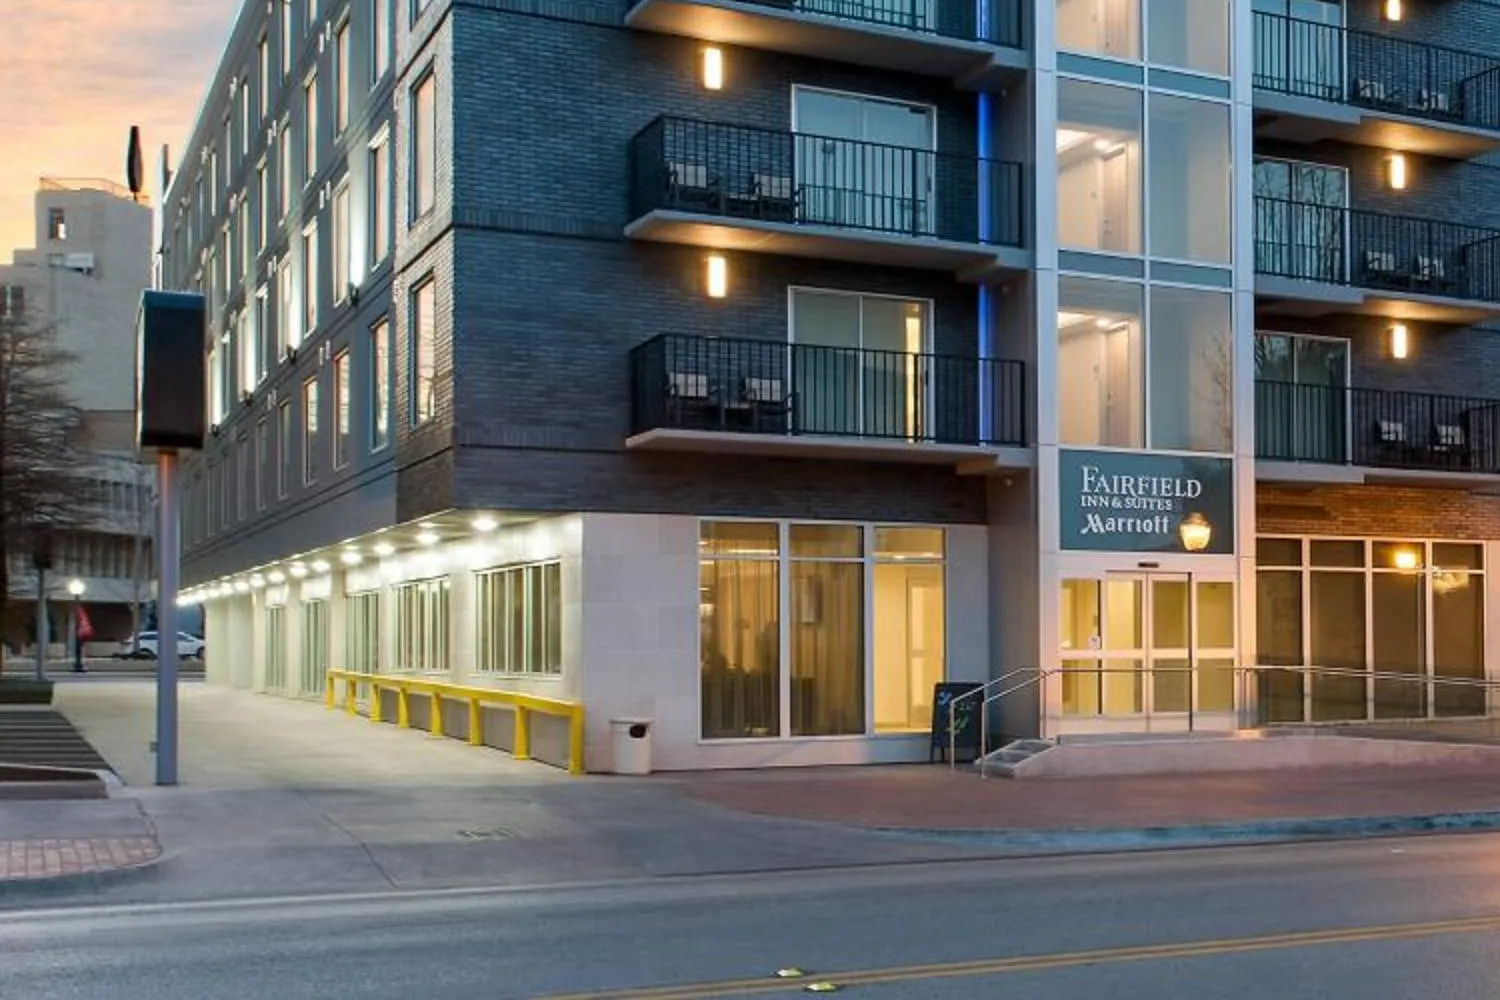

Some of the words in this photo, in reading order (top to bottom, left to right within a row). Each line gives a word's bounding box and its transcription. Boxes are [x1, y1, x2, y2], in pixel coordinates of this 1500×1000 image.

[1081, 465, 1202, 498] FAIRFIELD
[1081, 496, 1109, 508] INN
[1111, 498, 1122, 509] &
[1125, 498, 1173, 511] SUITES
[1080, 513, 1170, 535] Marriott
